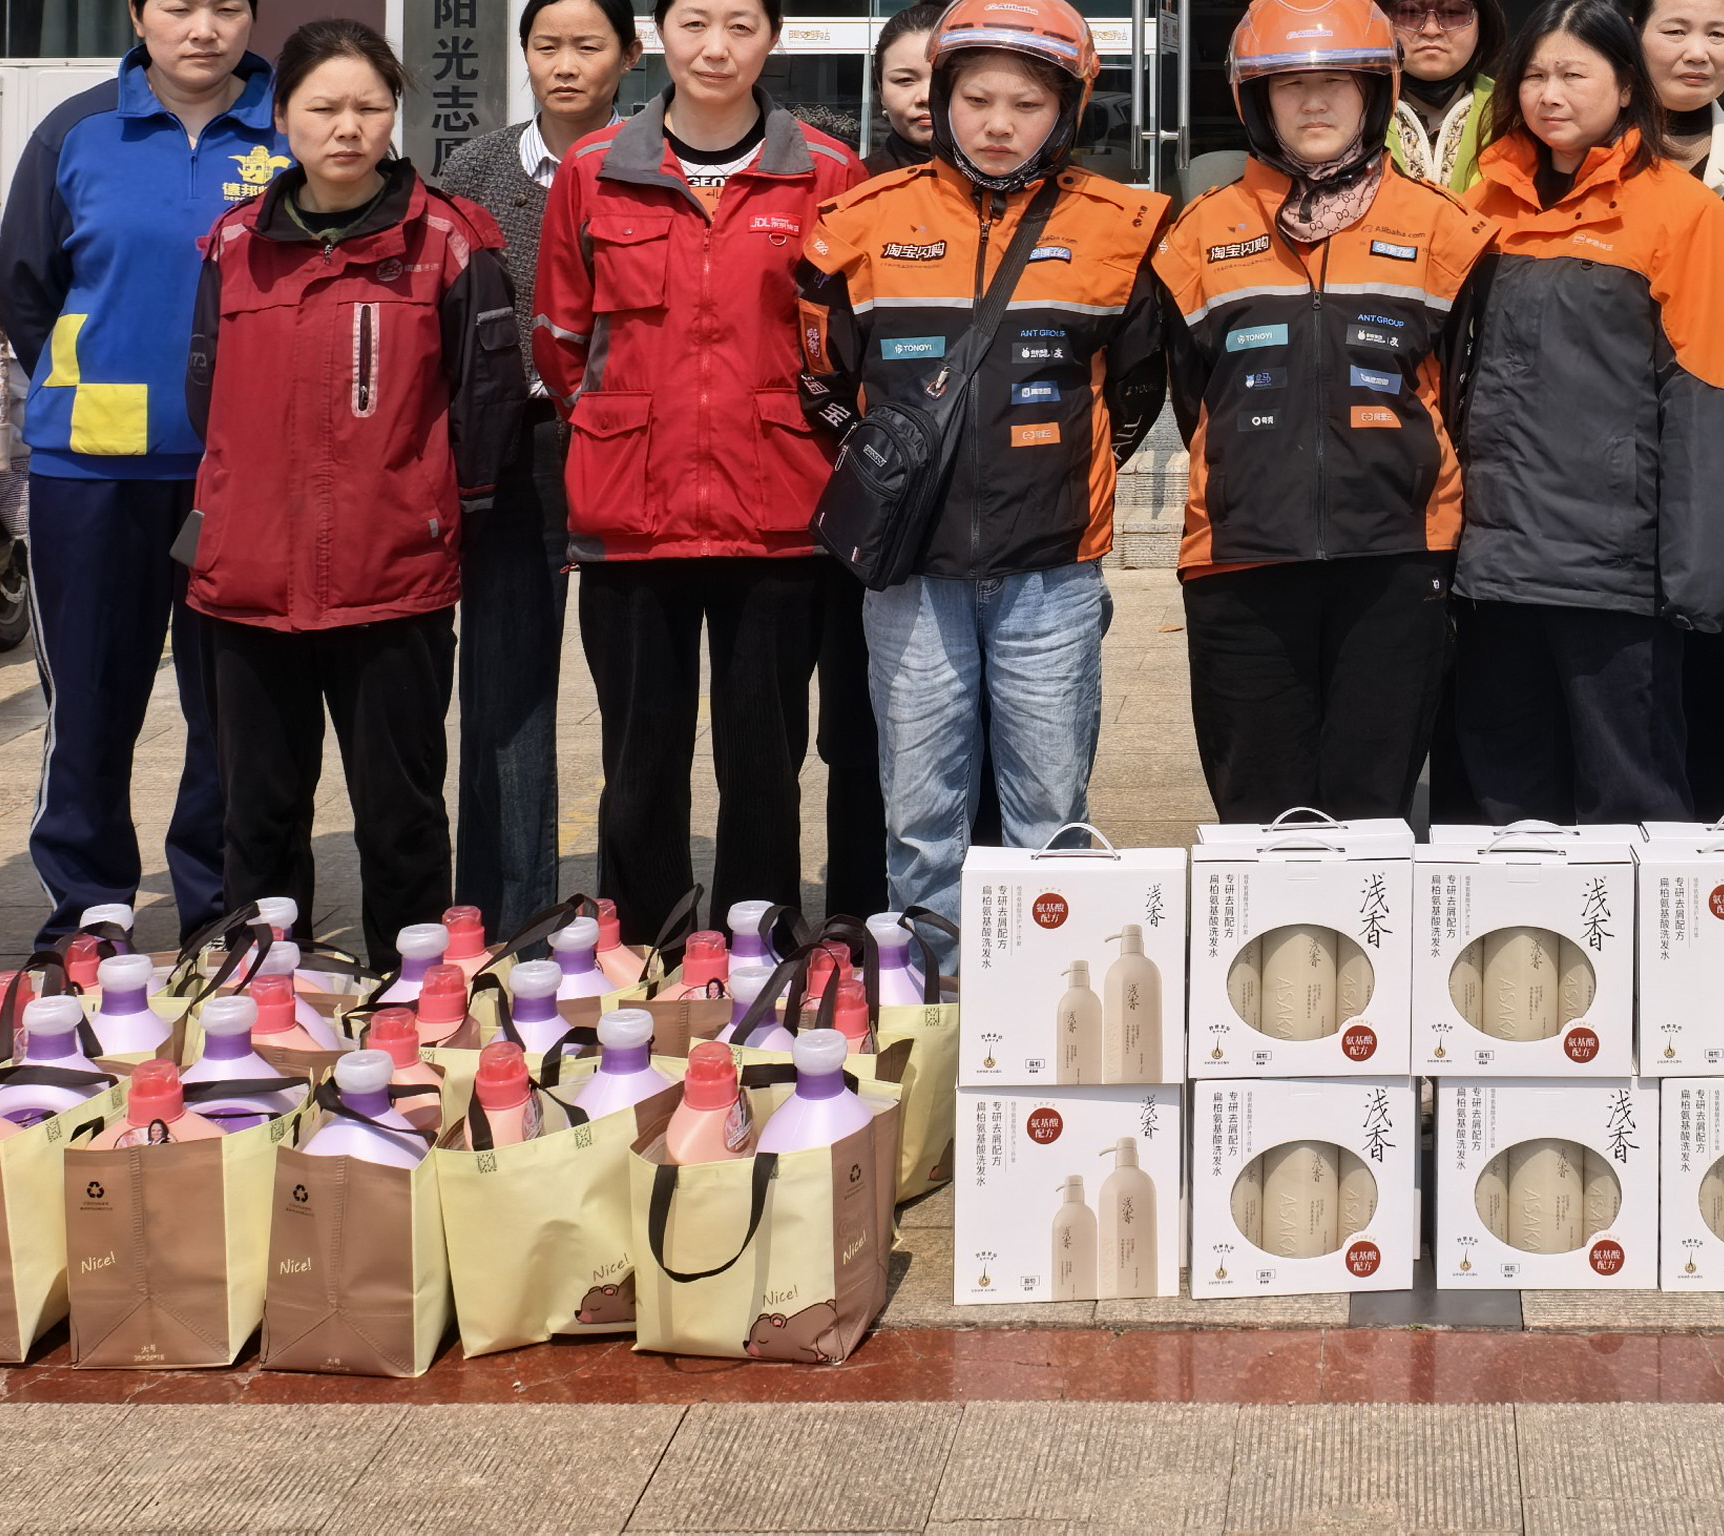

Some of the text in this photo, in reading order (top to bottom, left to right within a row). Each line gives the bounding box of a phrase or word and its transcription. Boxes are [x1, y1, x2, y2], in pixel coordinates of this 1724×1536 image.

[751, 217, 770, 227] JDL
[885, 242, 945, 259] 淘宝闪购
[1210, 235, 1269, 261] 淘宝闪购
[1358, 314, 1404, 327] ANT GROUP
[1246, 333, 1273, 341] TONGYI
[998, 885, 1008, 949] 专研去屑配方
[1036, 902, 1065, 912] 氨基酸
[1041, 913, 1059, 923] 配方
[1146, 883, 1164, 927] 浅香
[1209, 875, 1220, 958] 扁柏氨基酸洗发水
[1225, 875, 1235, 938] 专研去屑配方
[1358, 874, 1393, 948] 浅香
[1431, 875, 1441, 958] 扁柏氨基酸洗发水
[1446, 875, 1456, 938] 专研去屑配方
[1581, 877, 1614, 951] 浅香
[1660, 878, 1670, 960] 扁柏氨基酸洗发水
[1675, 878, 1685, 941] 专研去屑配方
[981, 885, 992, 969] 扁柏氨基酸洗发水
[1346, 1036, 1373, 1045] 氨基酸
[1348, 1046, 1368, 1057] 配方
[1567, 1038, 1595, 1047] 氨基酸
[1572, 1047, 1590, 1058] 配方
[1031, 1118, 1059, 1128] 氨基酸
[1140, 1095, 1159, 1139] 浅香
[1228, 1092, 1238, 1156] 专研去屑配方
[1362, 1089, 1396, 1163] 浅香
[1606, 1089, 1640, 1164] 浅香
[1035, 1128, 1054, 1139] 配方
[1213, 1092, 1222, 1176] 扁柏氨基酸洗发水
[81, 1252, 116, 1274] Nice!
[842, 1234, 867, 1265] Nice!
[280, 1258, 312, 1276] Nice!
[592, 1252, 630, 1280] Nice!
[763, 1289, 800, 1308] Nice!
